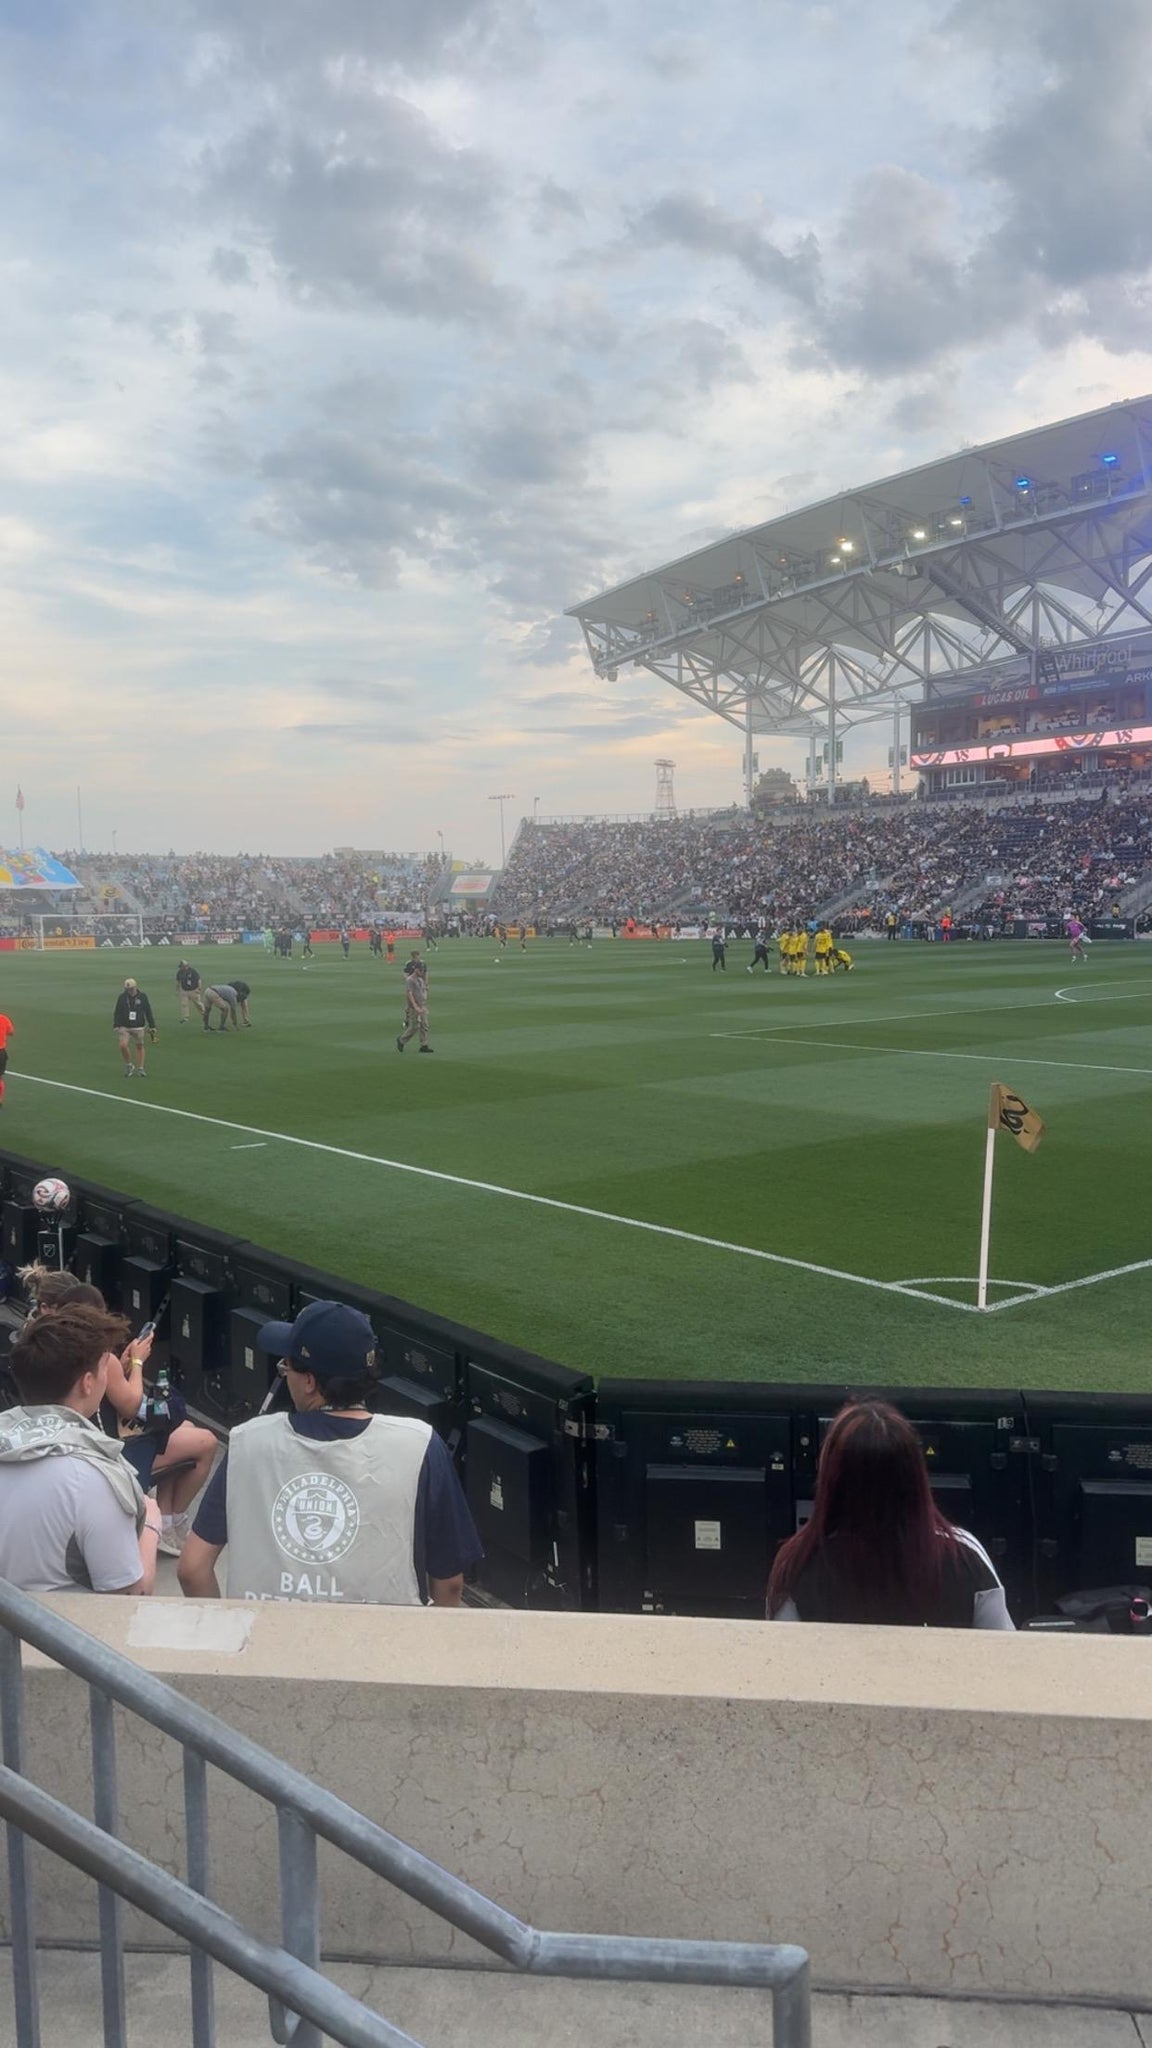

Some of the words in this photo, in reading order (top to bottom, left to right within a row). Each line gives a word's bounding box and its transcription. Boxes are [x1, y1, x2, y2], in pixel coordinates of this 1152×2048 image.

[1055, 644, 1132, 672] Whirlpool
[1124, 669, 1152, 684] ARK
[981, 690, 1013, 706] LUCAS
[1014, 687, 1030, 701] OIL
[1115, 730, 1132, 743] VS
[955, 749, 969, 762] VS
[276, 1475, 357, 1517] PHILADELPHIA
[299, 1500, 334, 1513] UNION
[280, 1572, 344, 1597] BALL
